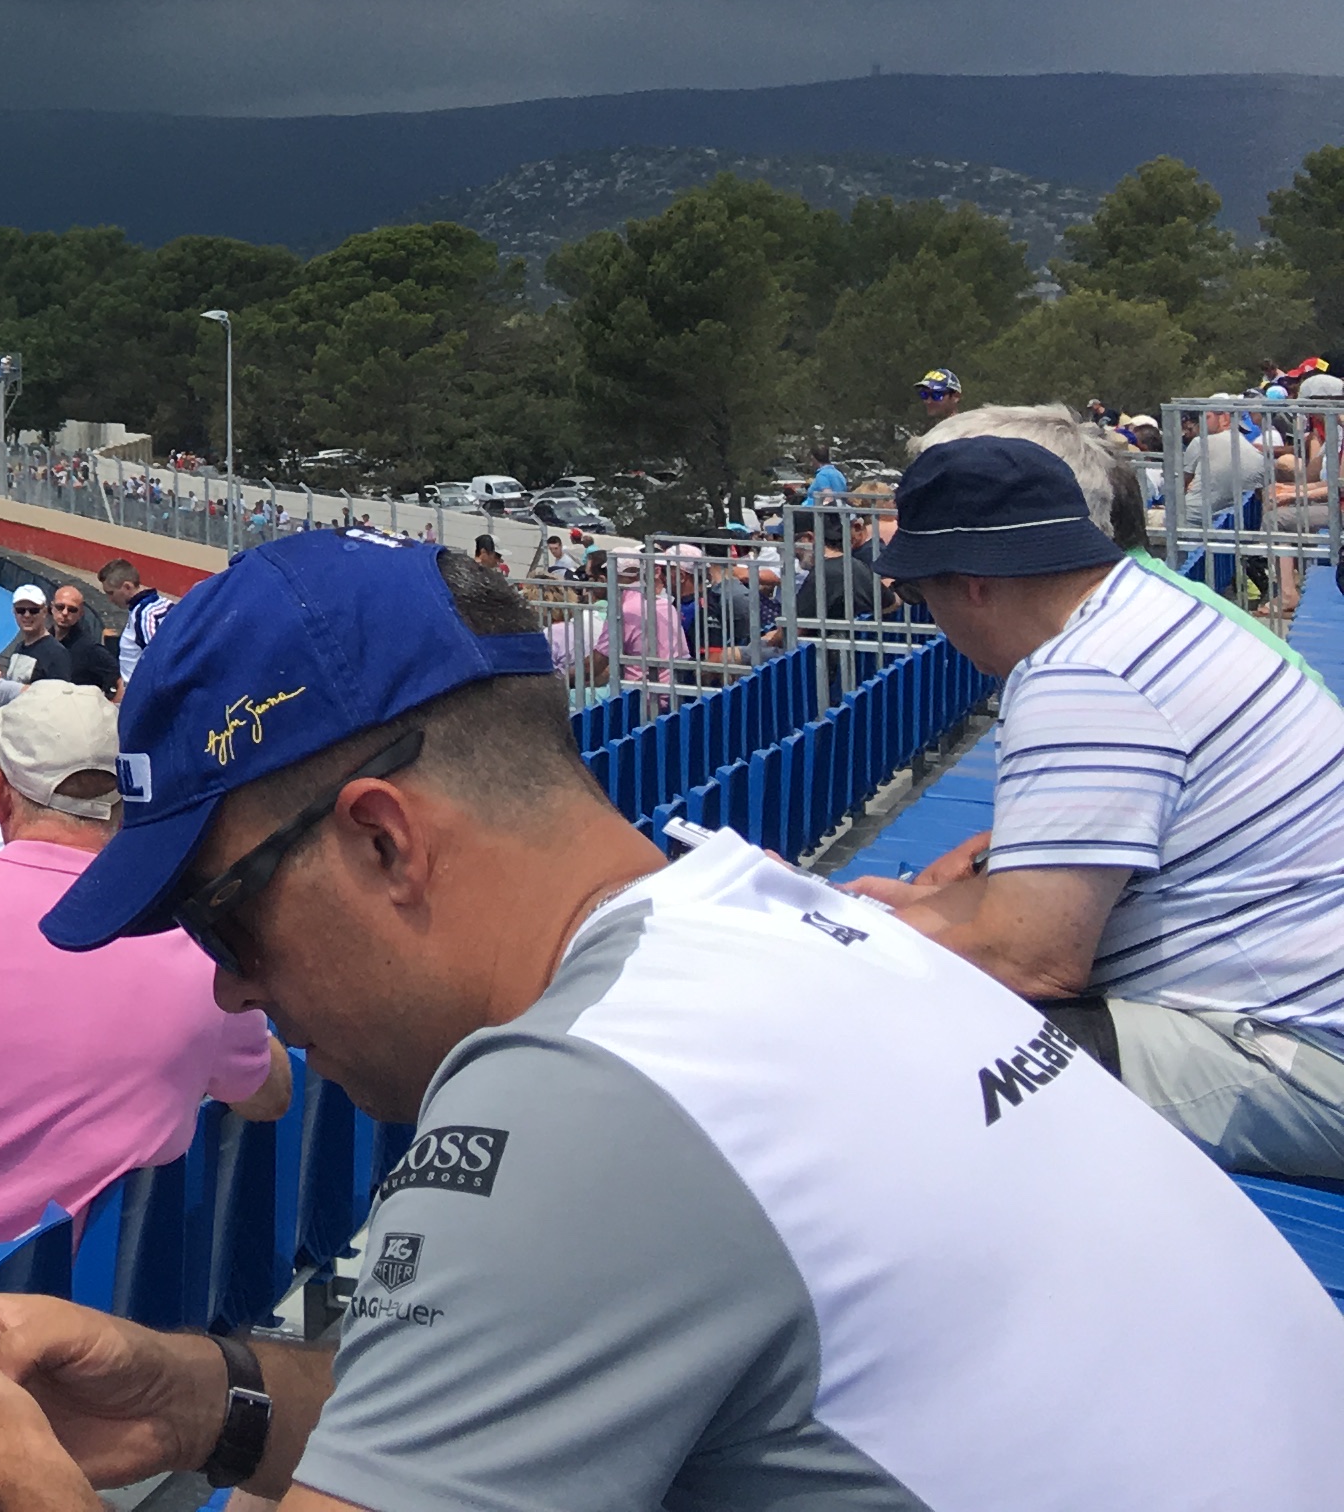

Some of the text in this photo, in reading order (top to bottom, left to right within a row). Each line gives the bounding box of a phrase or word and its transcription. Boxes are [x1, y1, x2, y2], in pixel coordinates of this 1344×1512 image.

[978, 1020, 1078, 1127] McLare
[383, 1171, 483, 1190] HUGO BOSS
[385, 1238, 413, 1260] TAG
[374, 1262, 413, 1287] HEUER
